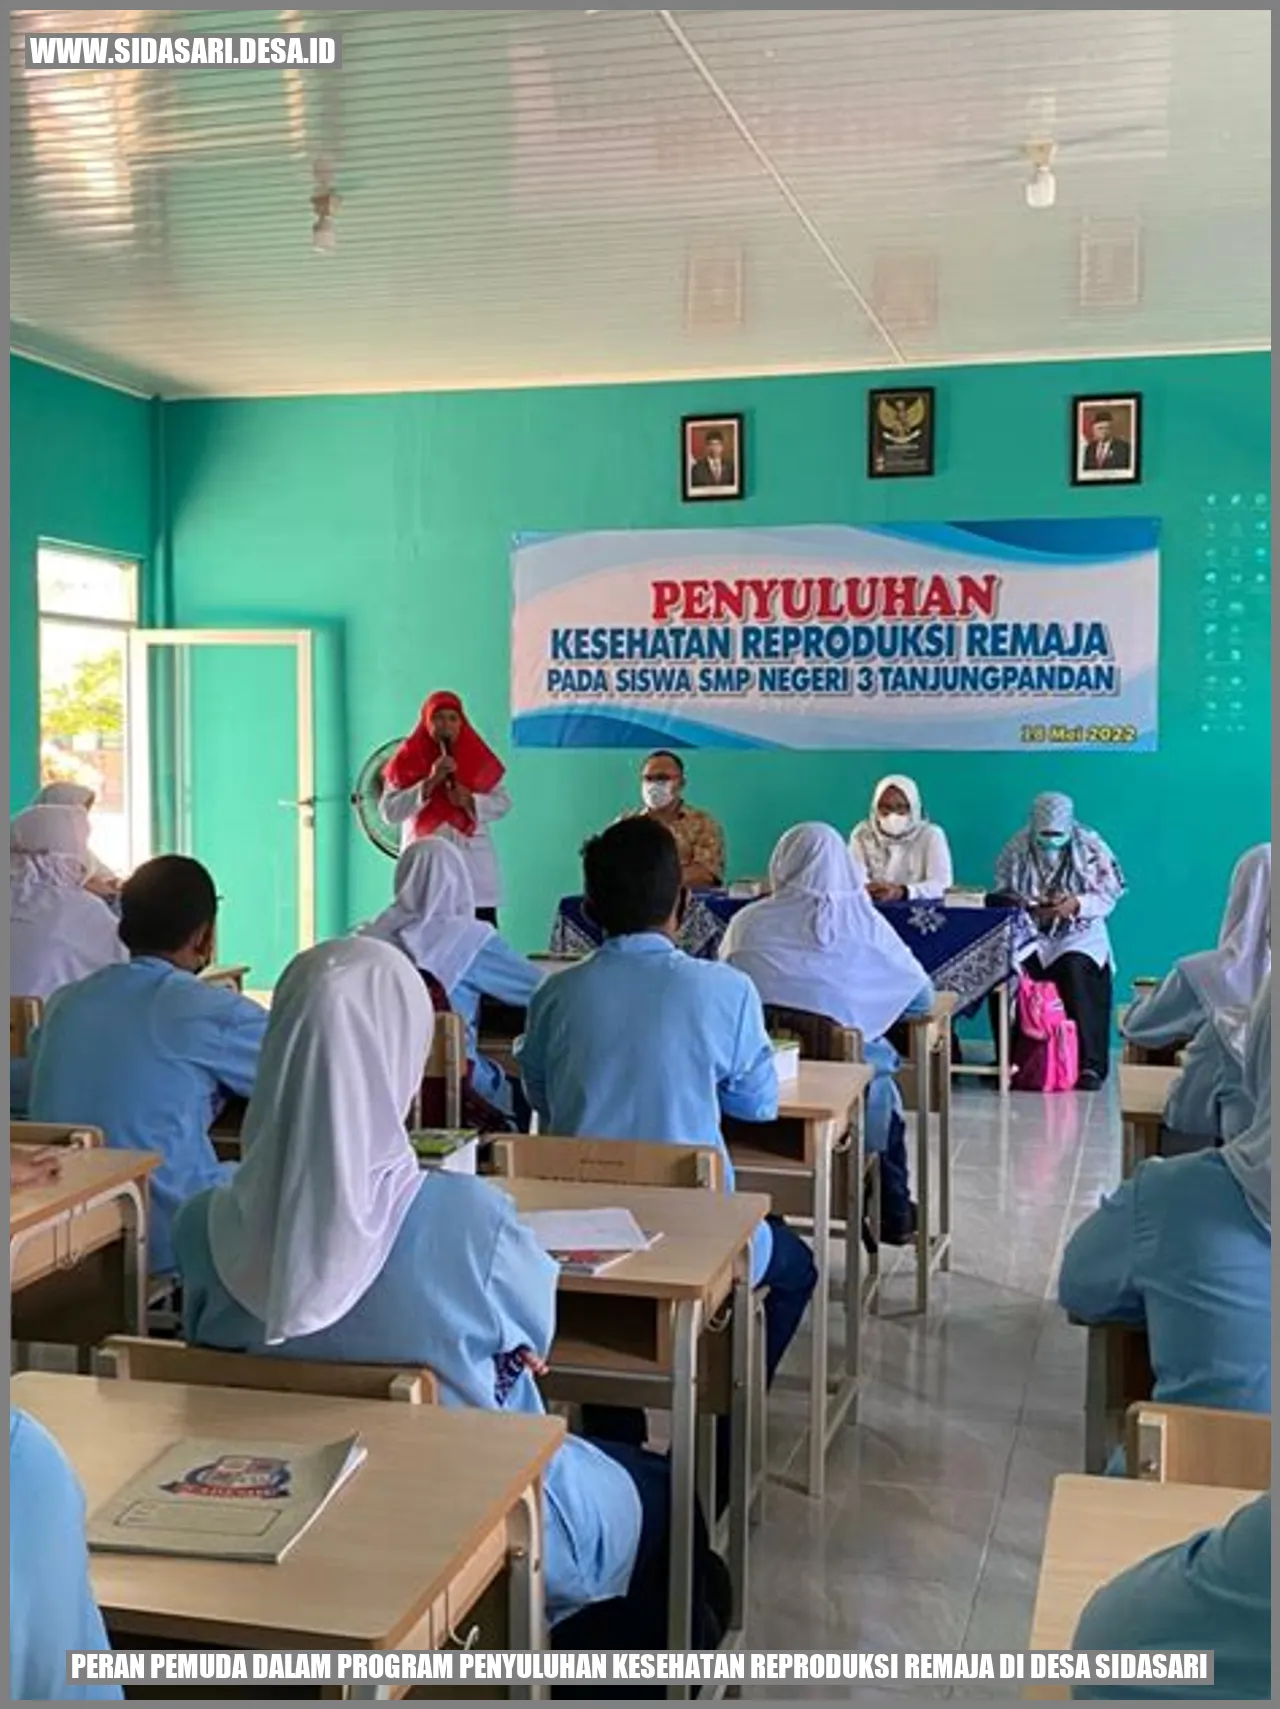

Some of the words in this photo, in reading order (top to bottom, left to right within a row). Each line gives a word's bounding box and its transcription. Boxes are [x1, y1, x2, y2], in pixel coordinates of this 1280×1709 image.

[651, 574, 998, 622] PENYULUHAN
[551, 627, 732, 661] KESEHATAN
[741, 623, 956, 660] REPRODUKSI
[966, 621, 1109, 658] REMAJA
[547, 668, 609, 693] PADA
[699, 666, 751, 693] SMP
[758, 666, 850, 692] NEGERI
[857, 666, 874, 692] 3
[878, 665, 1115, 692] TANJUNGPANDAN
[1086, 723, 1137, 743] 2022
